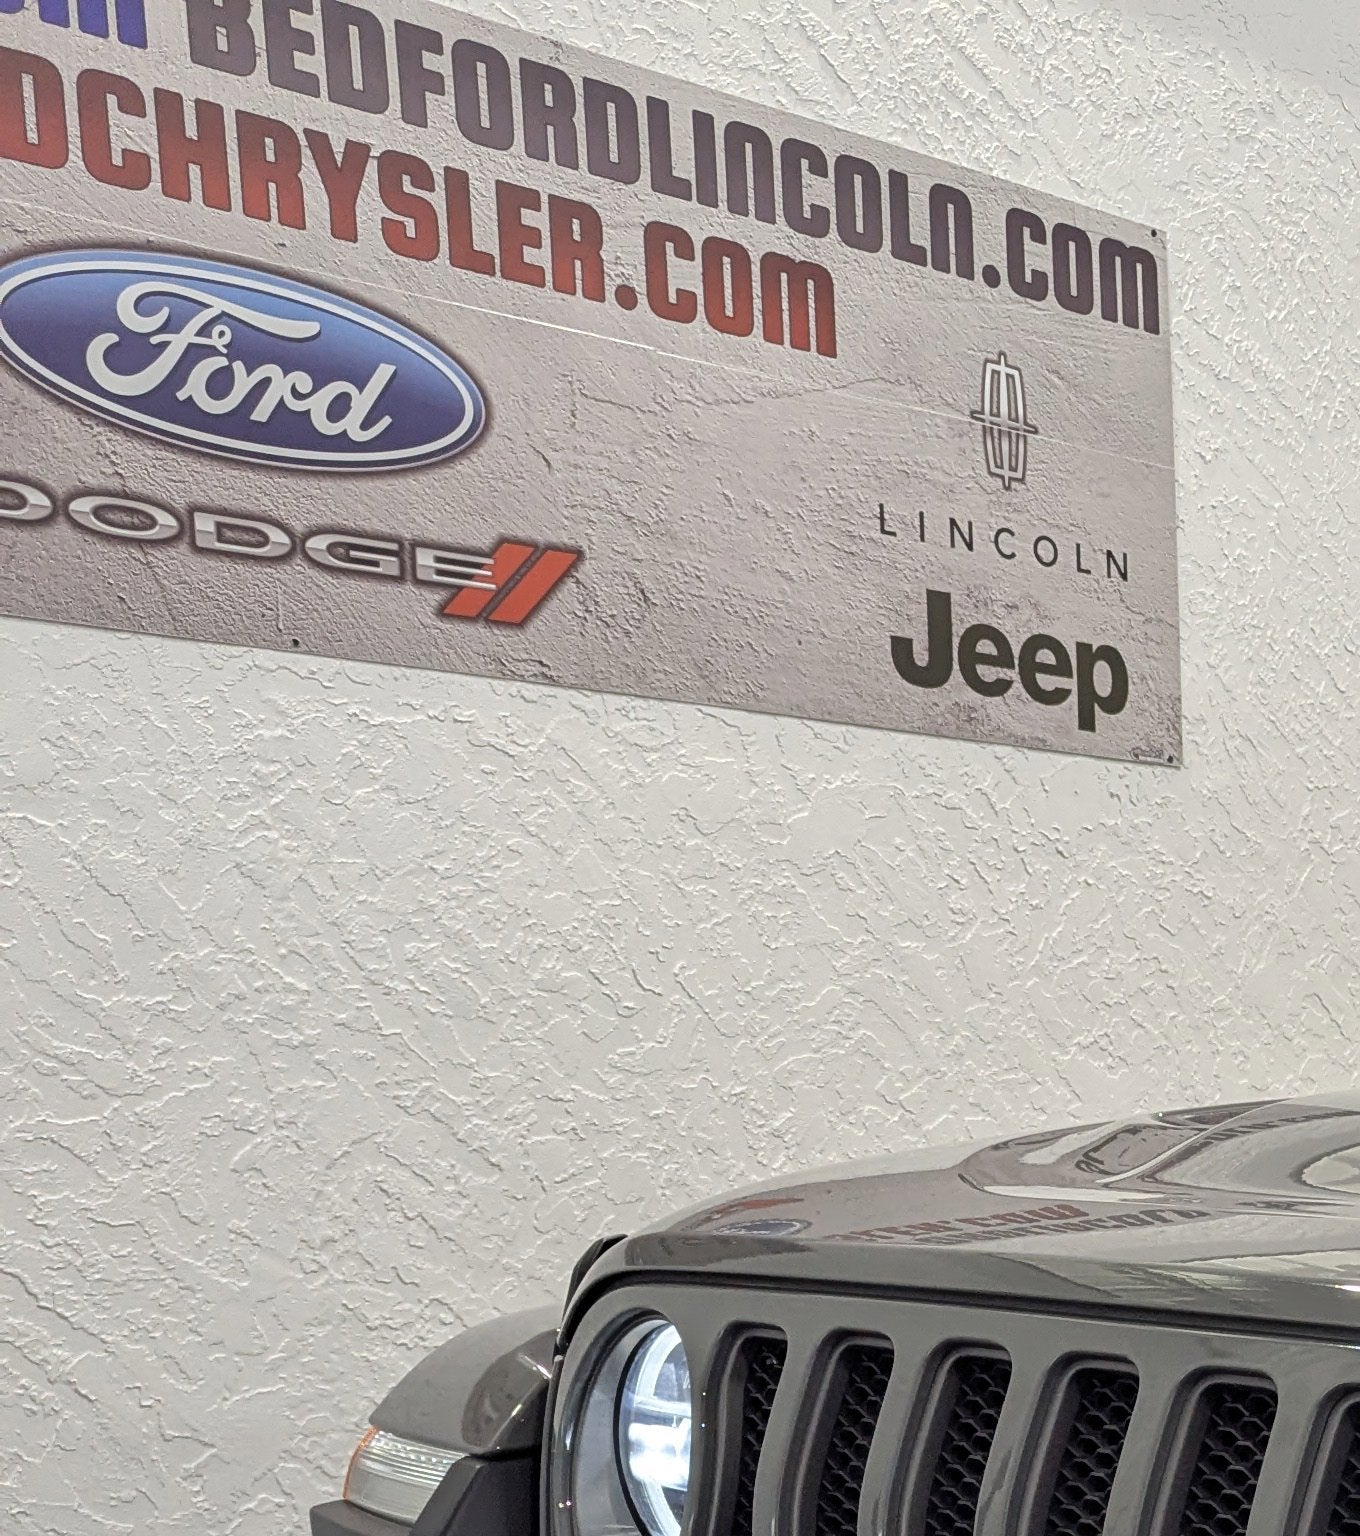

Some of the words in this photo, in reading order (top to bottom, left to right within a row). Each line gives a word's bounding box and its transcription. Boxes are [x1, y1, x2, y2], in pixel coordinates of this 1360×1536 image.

[88, 281, 396, 446] Ford
[877, 502, 1131, 582] LINCOLN
[890, 588, 1129, 731] Jeep
